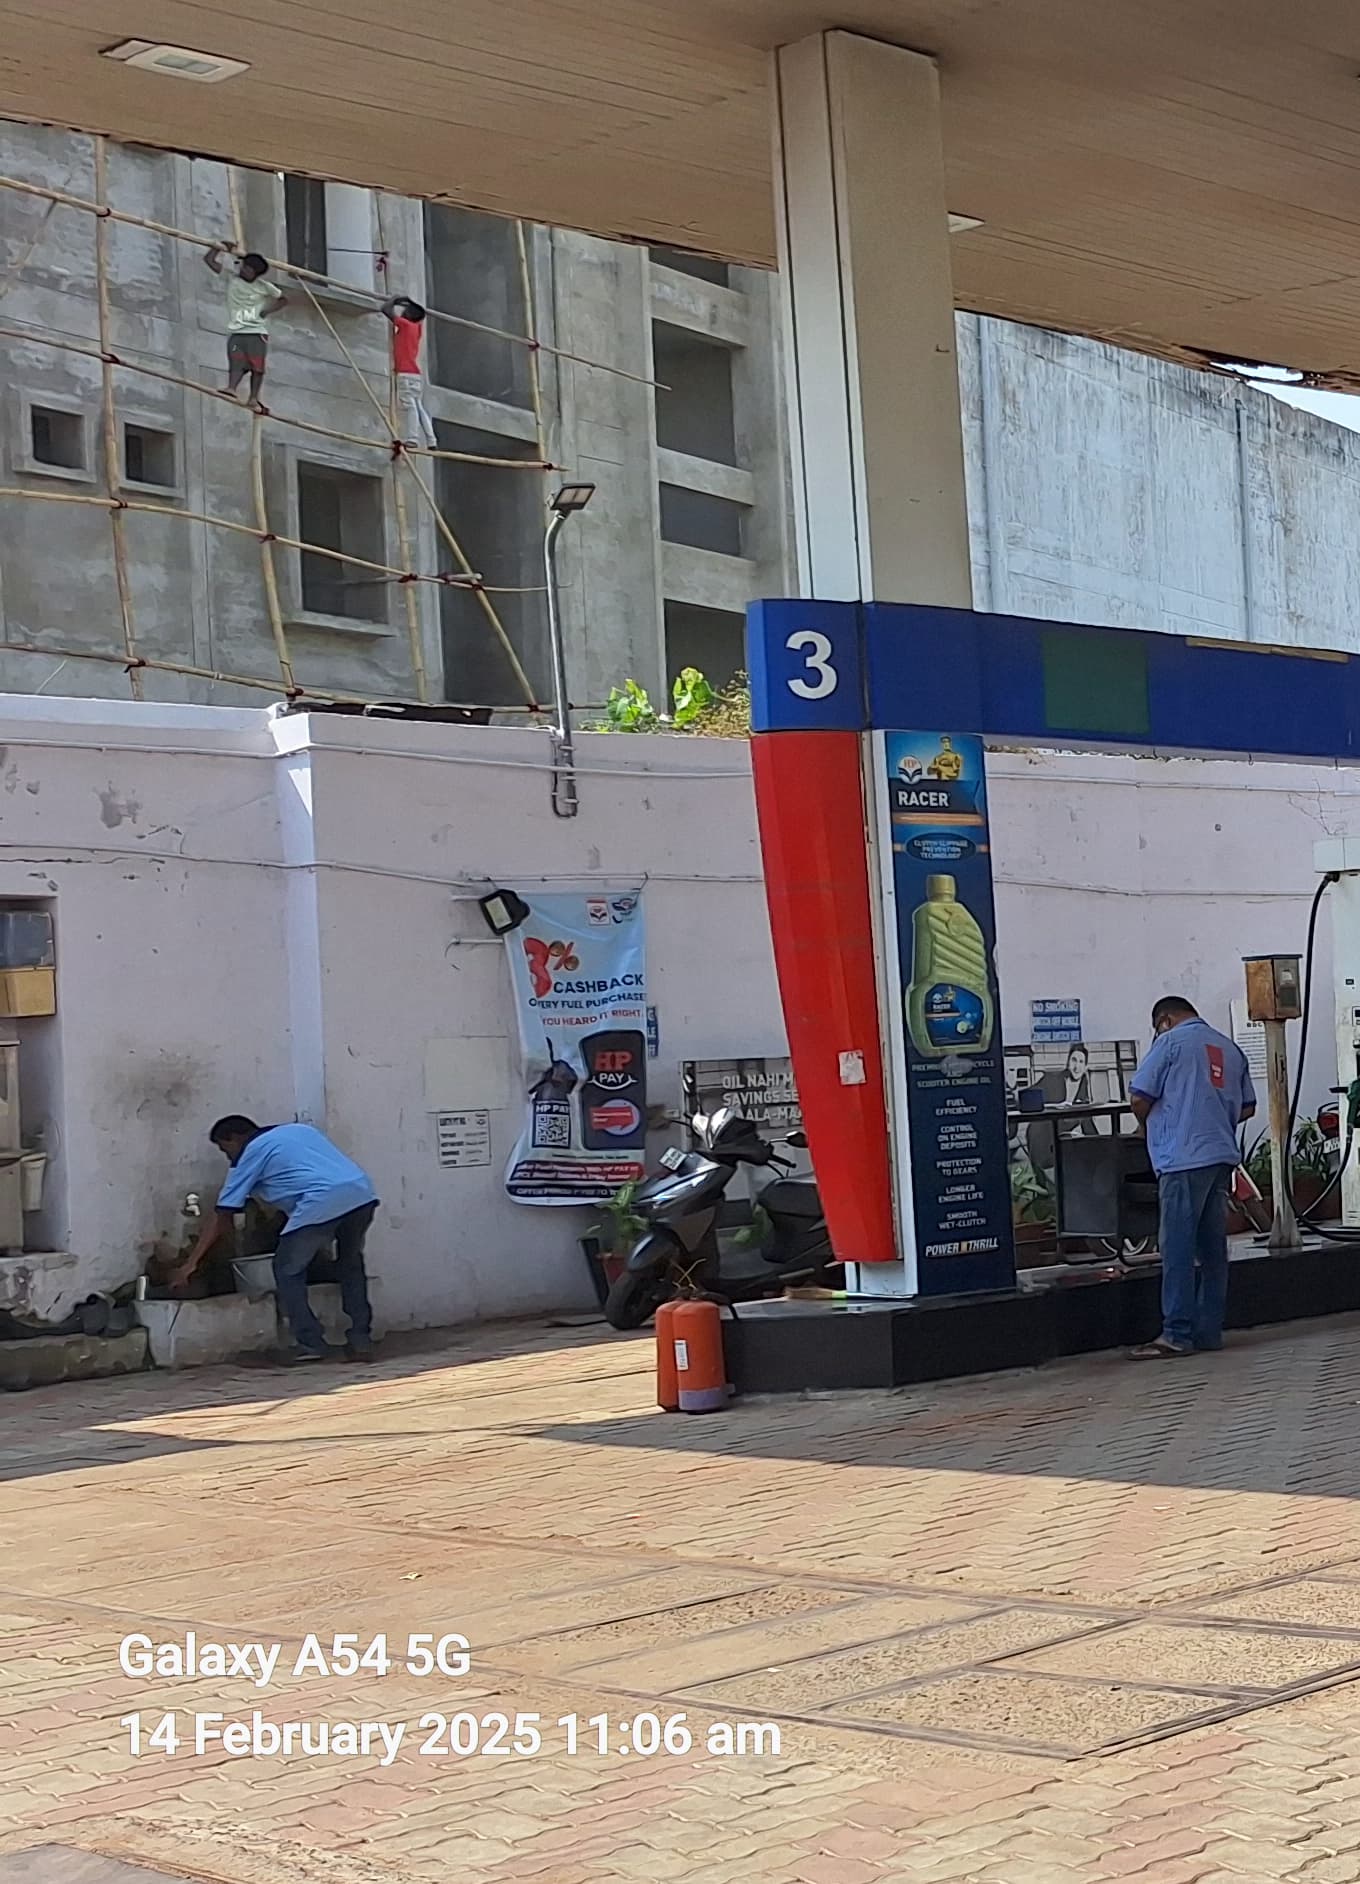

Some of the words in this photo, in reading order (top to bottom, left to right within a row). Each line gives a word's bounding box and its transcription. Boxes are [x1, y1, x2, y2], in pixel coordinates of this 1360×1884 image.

[786, 631, 837, 699] 3
[898, 790, 949, 807] RACER
[523, 937, 579, 998] 3%
[553, 974, 644, 994] CASHBACK
[562, 1015, 598, 1026] HEARD
[595, 1052, 632, 1071] HP
[599, 1073, 624, 1083] PAY
[722, 1075, 744, 1089] OIL
[722, 1090, 781, 1106] SAVINGS
[946, 1098, 966, 1106] FUEL
[536, 1104, 551, 1113] HP
[935, 1106, 977, 1116] EFFICIENCY
[940, 1124, 974, 1133] CONTROL
[940, 1141, 977, 1150] DEPOSITS
[936, 1157, 982, 1168] PROTECTION
[946, 1184, 976, 1195] LONGER
[938, 1193, 967, 1204] ENGINE
[968, 1191, 984, 1200] LIFE
[946, 1210, 978, 1220] SMOOTH
[925, 1242, 960, 1257] POWER
[965, 1237, 999, 1251] THRILL
